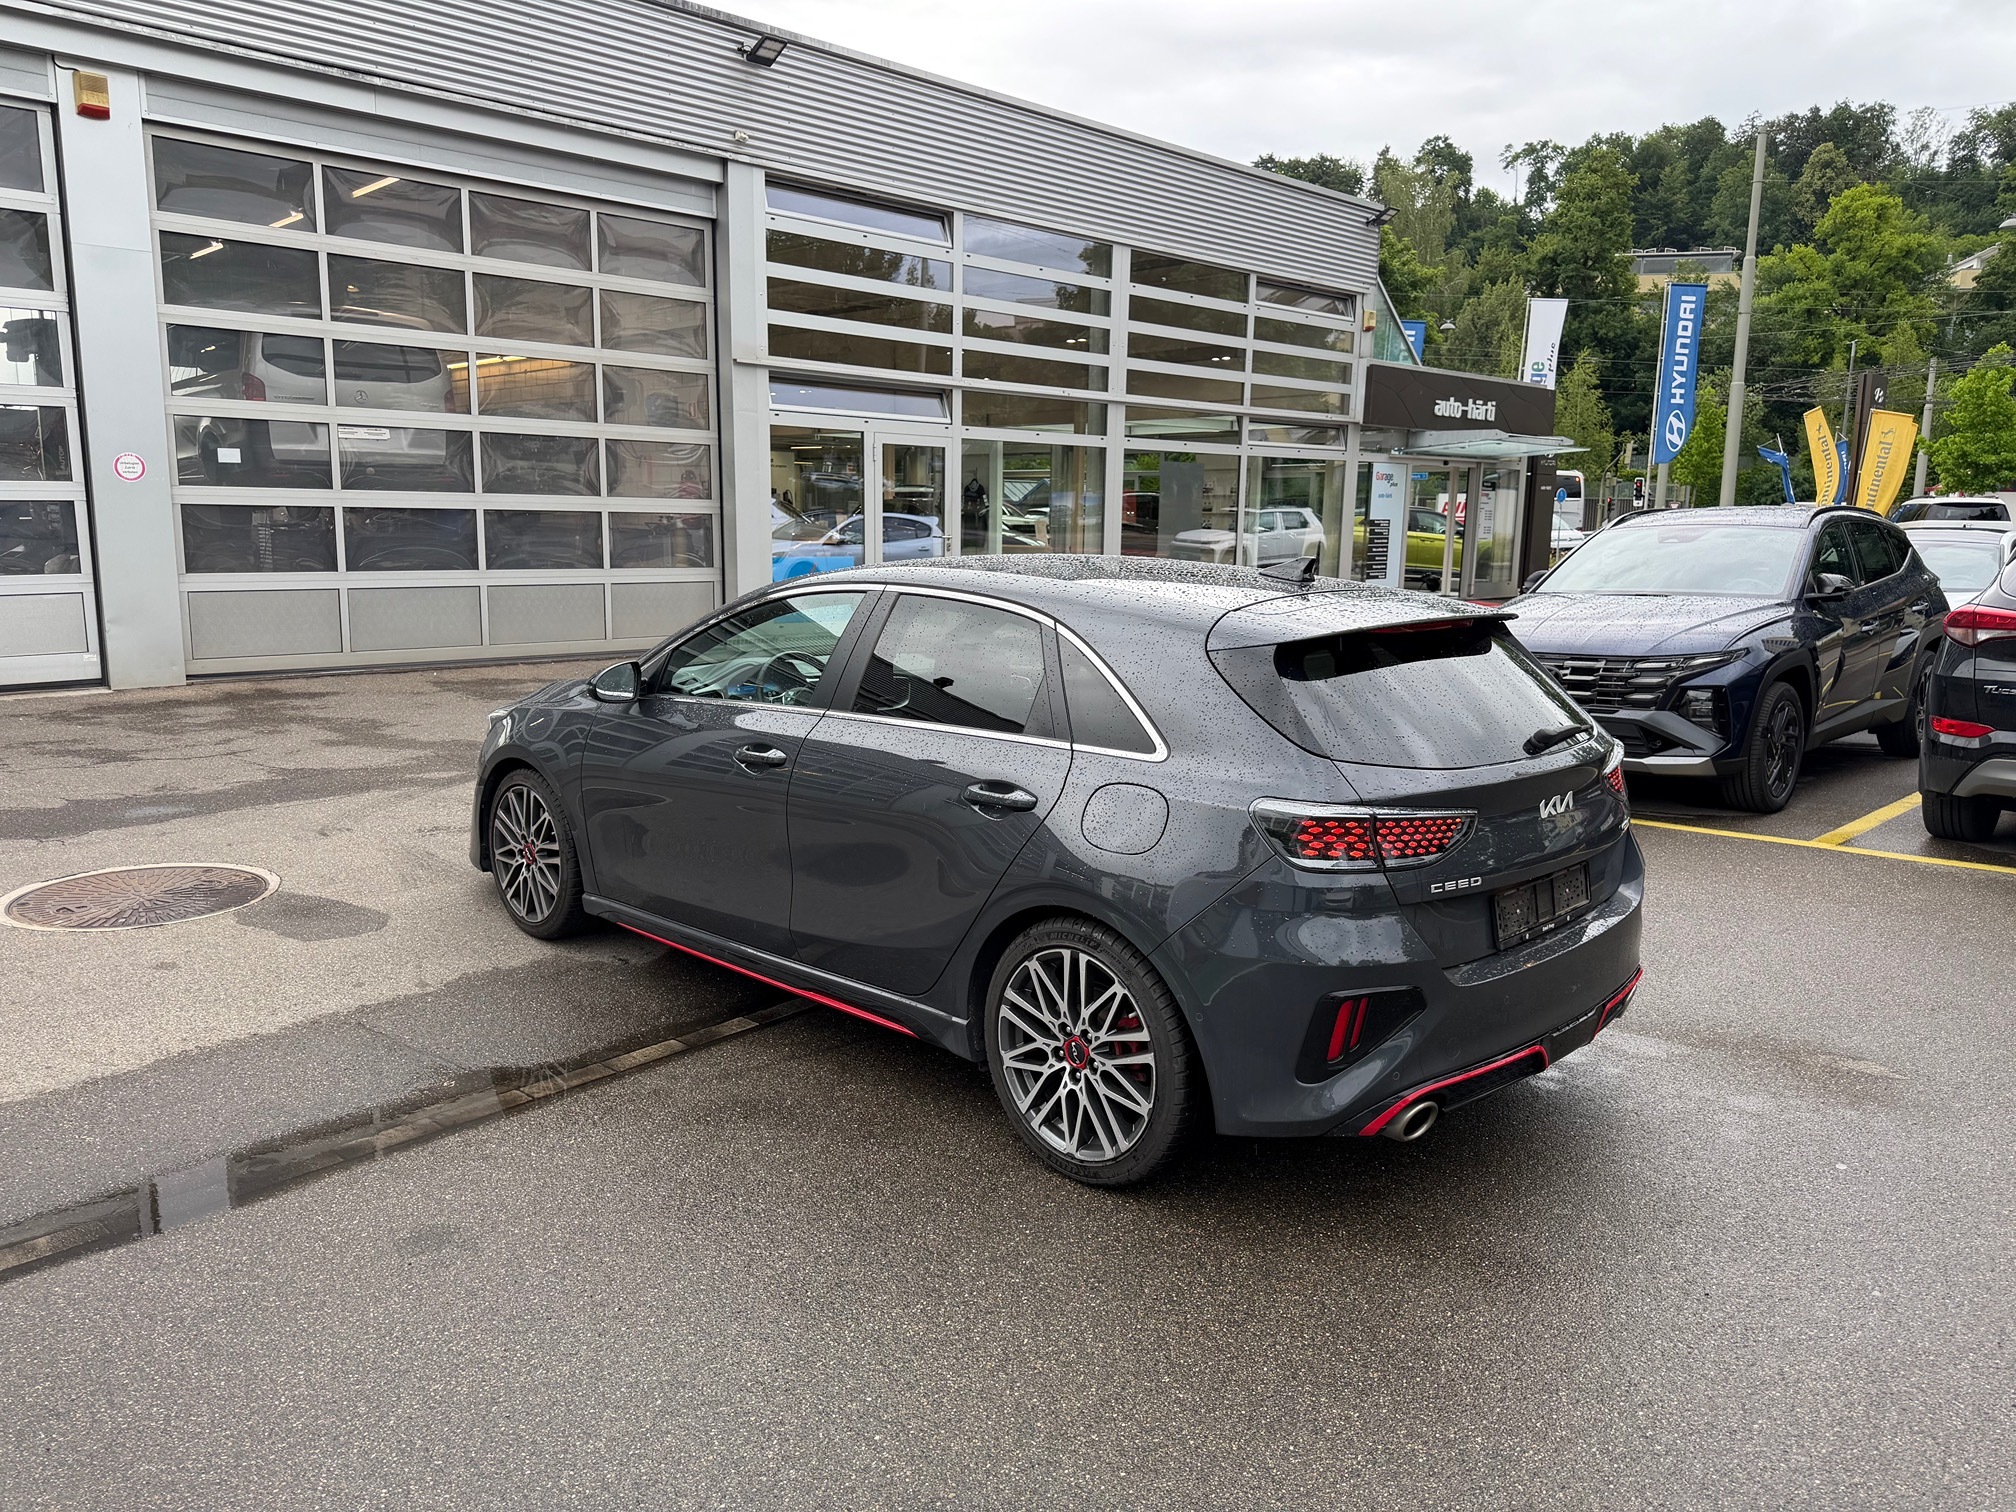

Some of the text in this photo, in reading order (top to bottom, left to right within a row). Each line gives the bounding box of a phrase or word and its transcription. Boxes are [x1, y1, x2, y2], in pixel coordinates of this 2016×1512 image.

[1671, 295, 1697, 404] HYUNDAI
[1434, 396, 1496, 422] auto-härti
[1376, 471, 1394, 484] Garage
[1818, 435, 1833, 506] ontinental
[1865, 440, 1893, 509] ntinental
[1539, 790, 1574, 819] KIA
[1430, 876, 1482, 894] CEED
